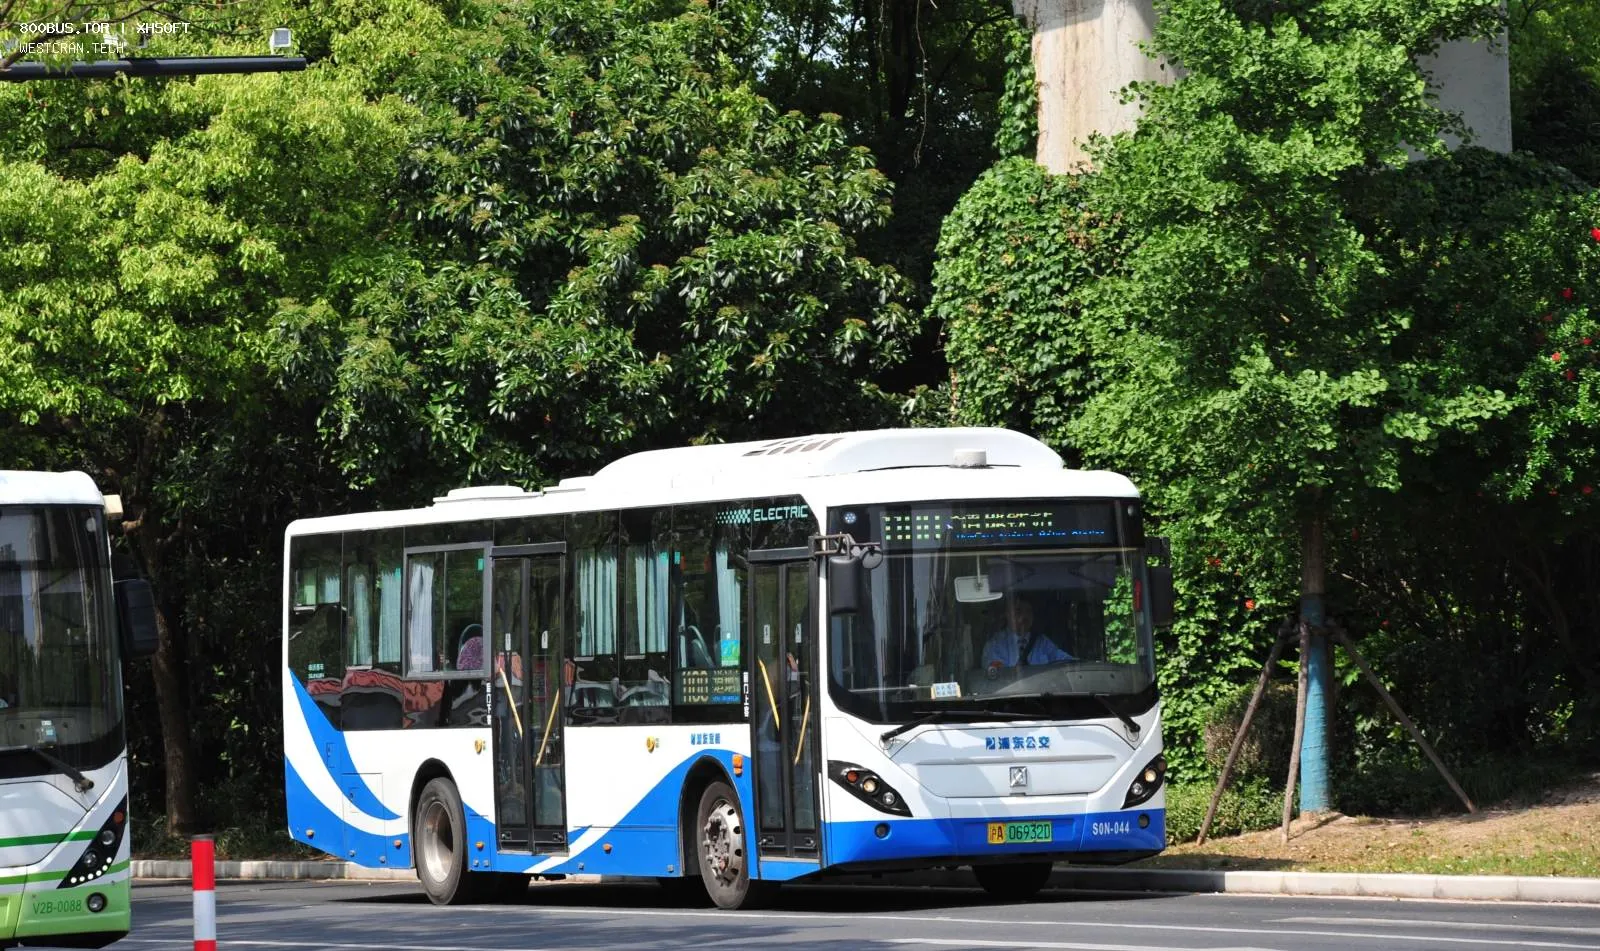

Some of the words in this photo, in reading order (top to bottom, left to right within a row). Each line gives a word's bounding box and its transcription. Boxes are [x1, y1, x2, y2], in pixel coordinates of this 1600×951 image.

[753, 504, 808, 521] ELECTRIC
[998, 735, 1050, 750] 浦东公交
[32, 899, 82, 914] V2B-0088
